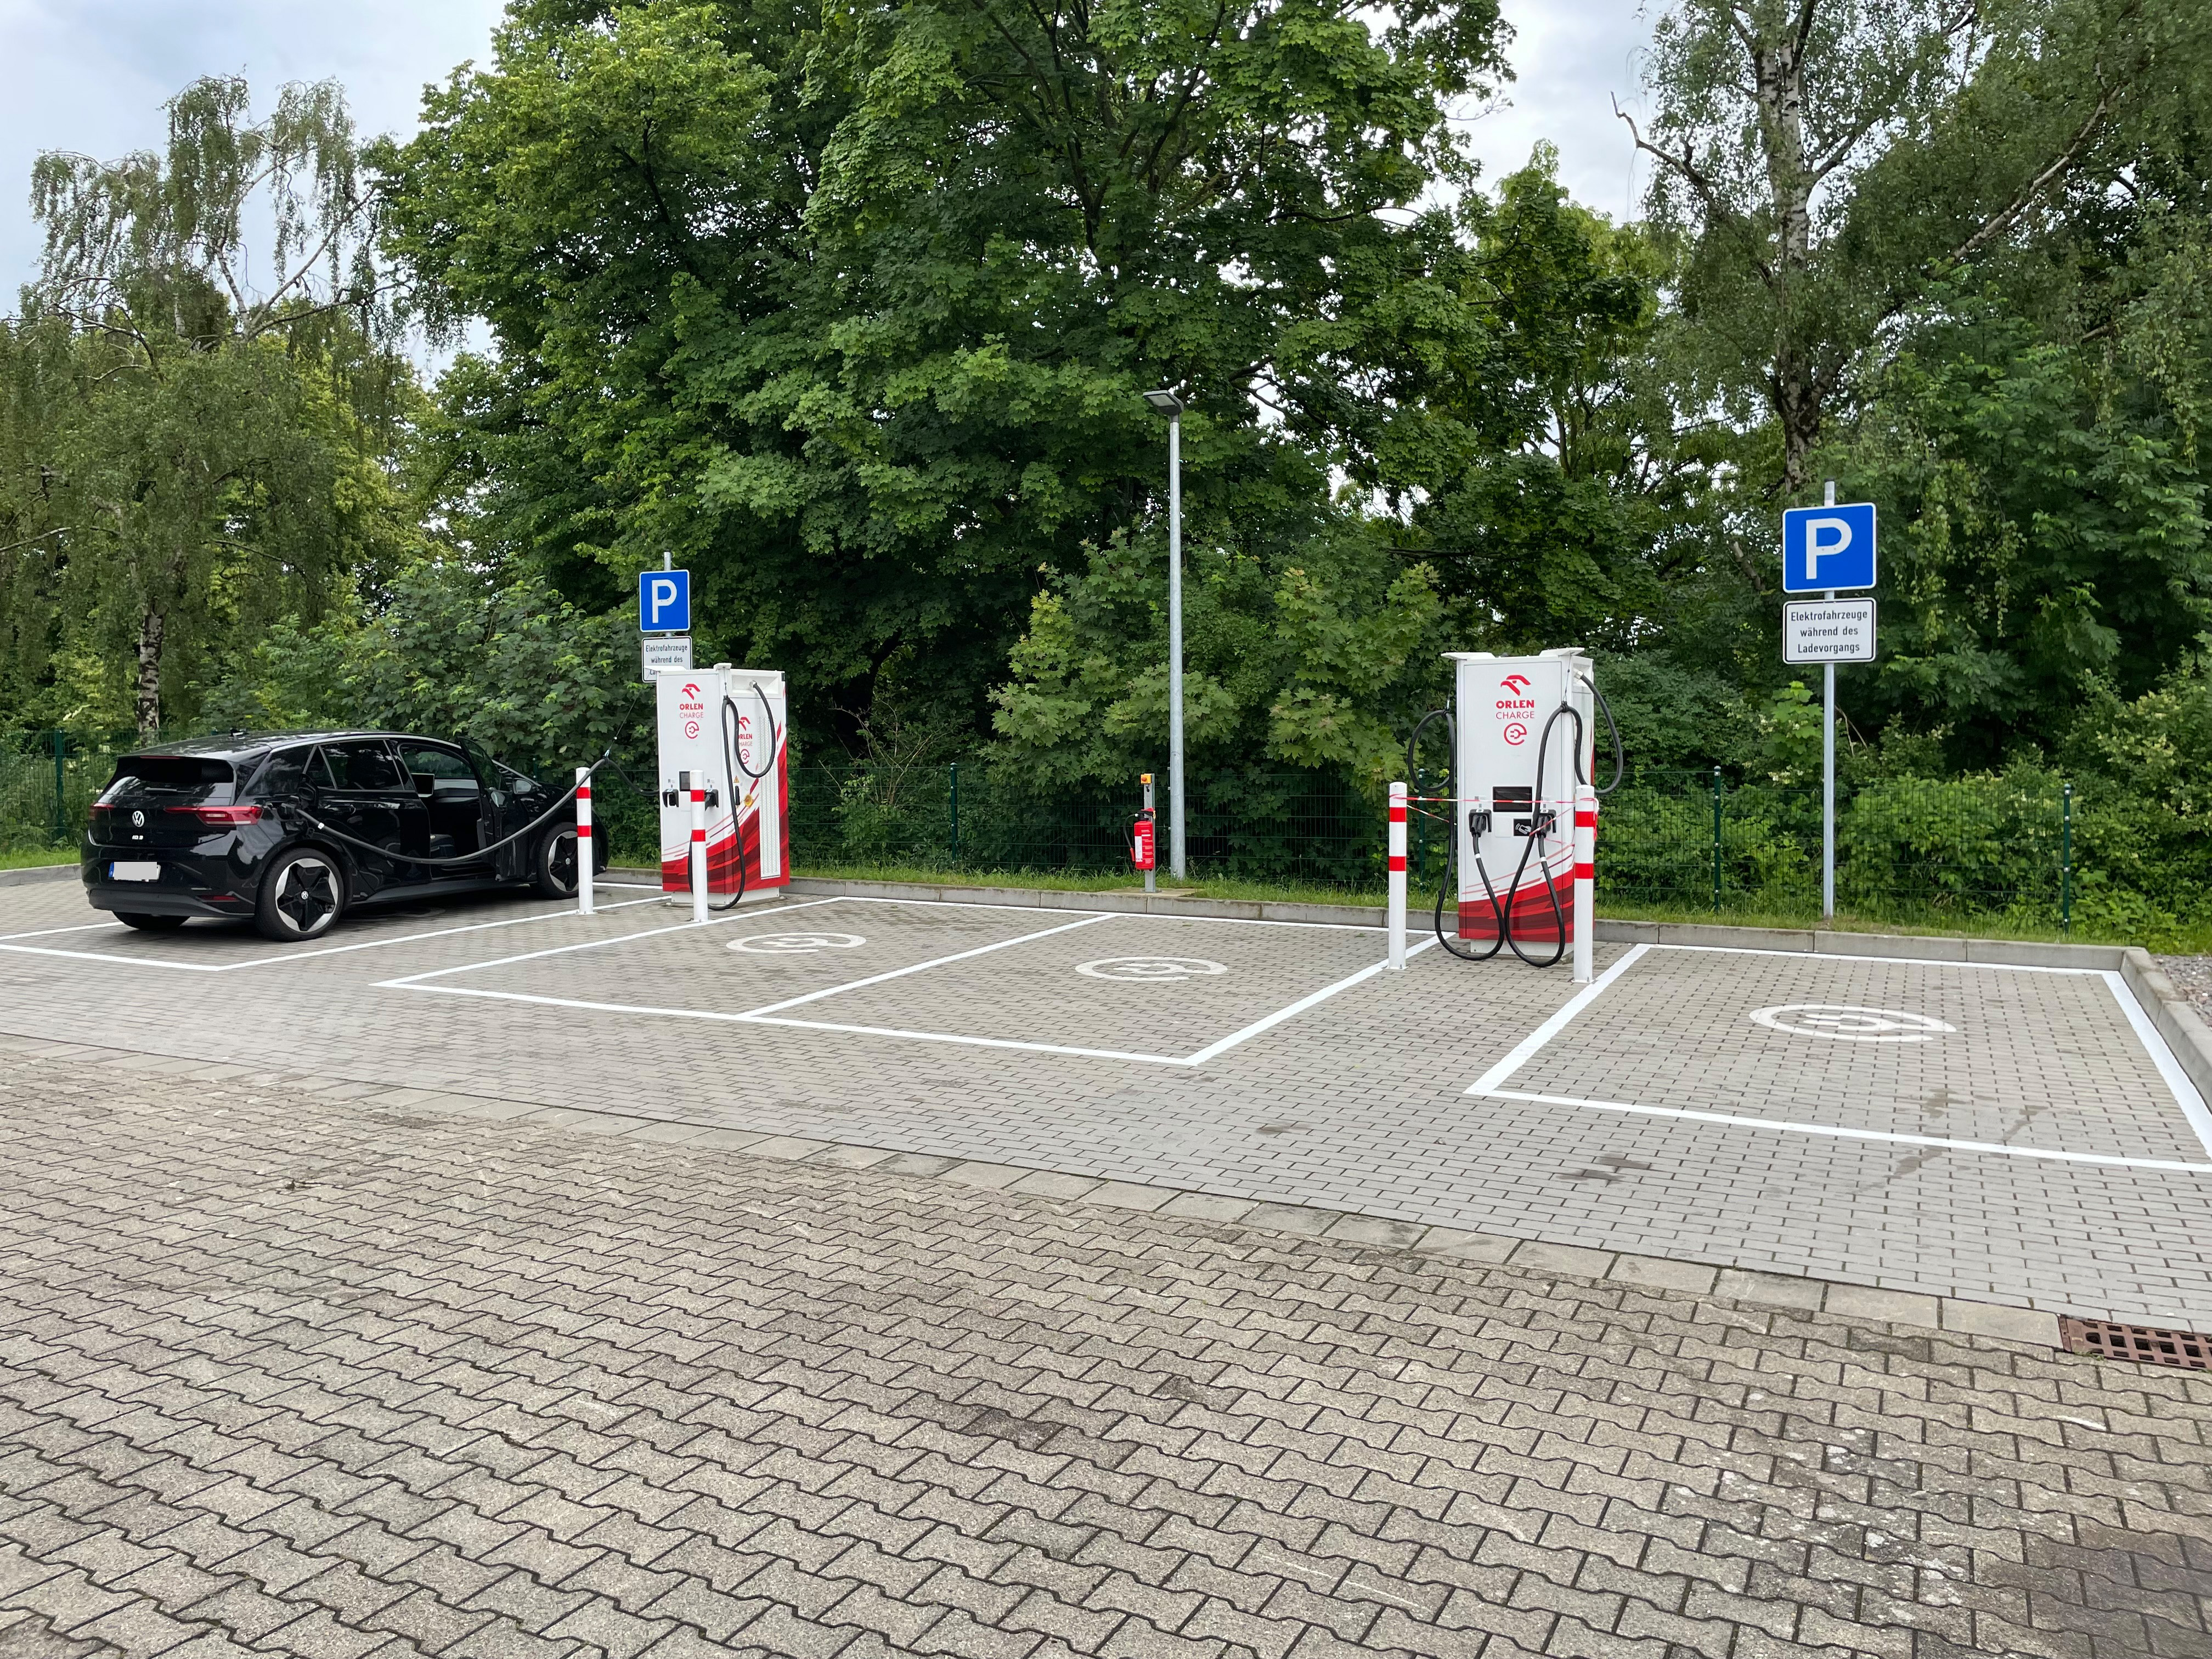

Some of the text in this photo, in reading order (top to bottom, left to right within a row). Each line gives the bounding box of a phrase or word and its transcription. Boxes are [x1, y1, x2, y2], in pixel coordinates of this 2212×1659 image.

[1806, 517, 1852, 580] P
[652, 579, 677, 623] P
[1791, 610, 1867, 621] Elektrofahrzeuge
[1800, 626, 1858, 637] während des
[646, 644, 687, 652] Elektrofahrzeuge
[1798, 642, 1860, 654] Ladevorgangs
[1496, 699, 1534, 709] ORLEN
[1496, 711, 1534, 719] CHARGE
